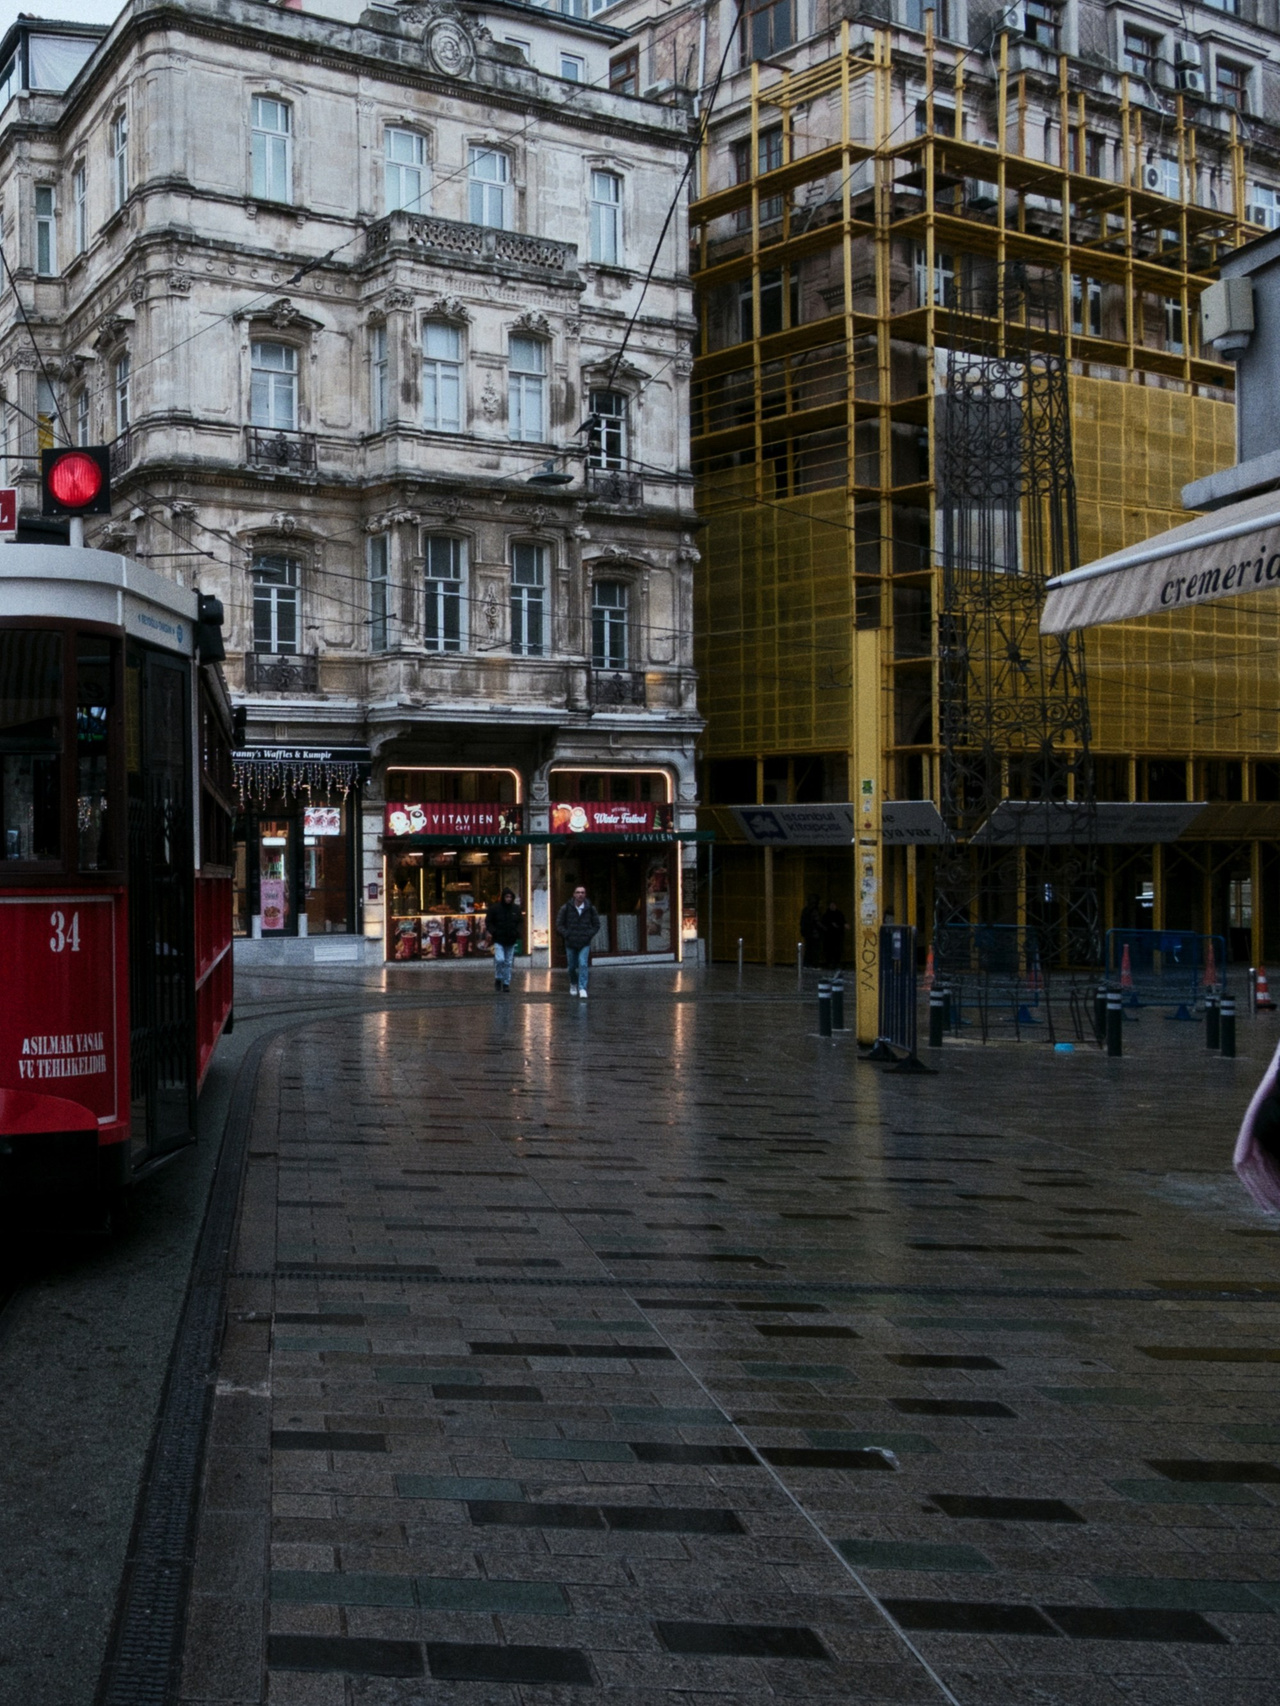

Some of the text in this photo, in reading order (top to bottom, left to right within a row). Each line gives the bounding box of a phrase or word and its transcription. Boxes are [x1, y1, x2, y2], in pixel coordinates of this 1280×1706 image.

[231, 750, 261, 762] ranny's
[263, 750, 293, 761] Waffles
[303, 750, 332, 761] Kumpir
[432, 814, 494, 824] VITAVIEN
[463, 836, 518, 845] VITAVIEN
[623, 834, 674, 842] VITAVIEN
[49, 910, 81, 952] 34
[22, 1032, 104, 1056] ASILMAK YASAK
[36, 1054, 107, 1079] TEHLIKELIDIR
